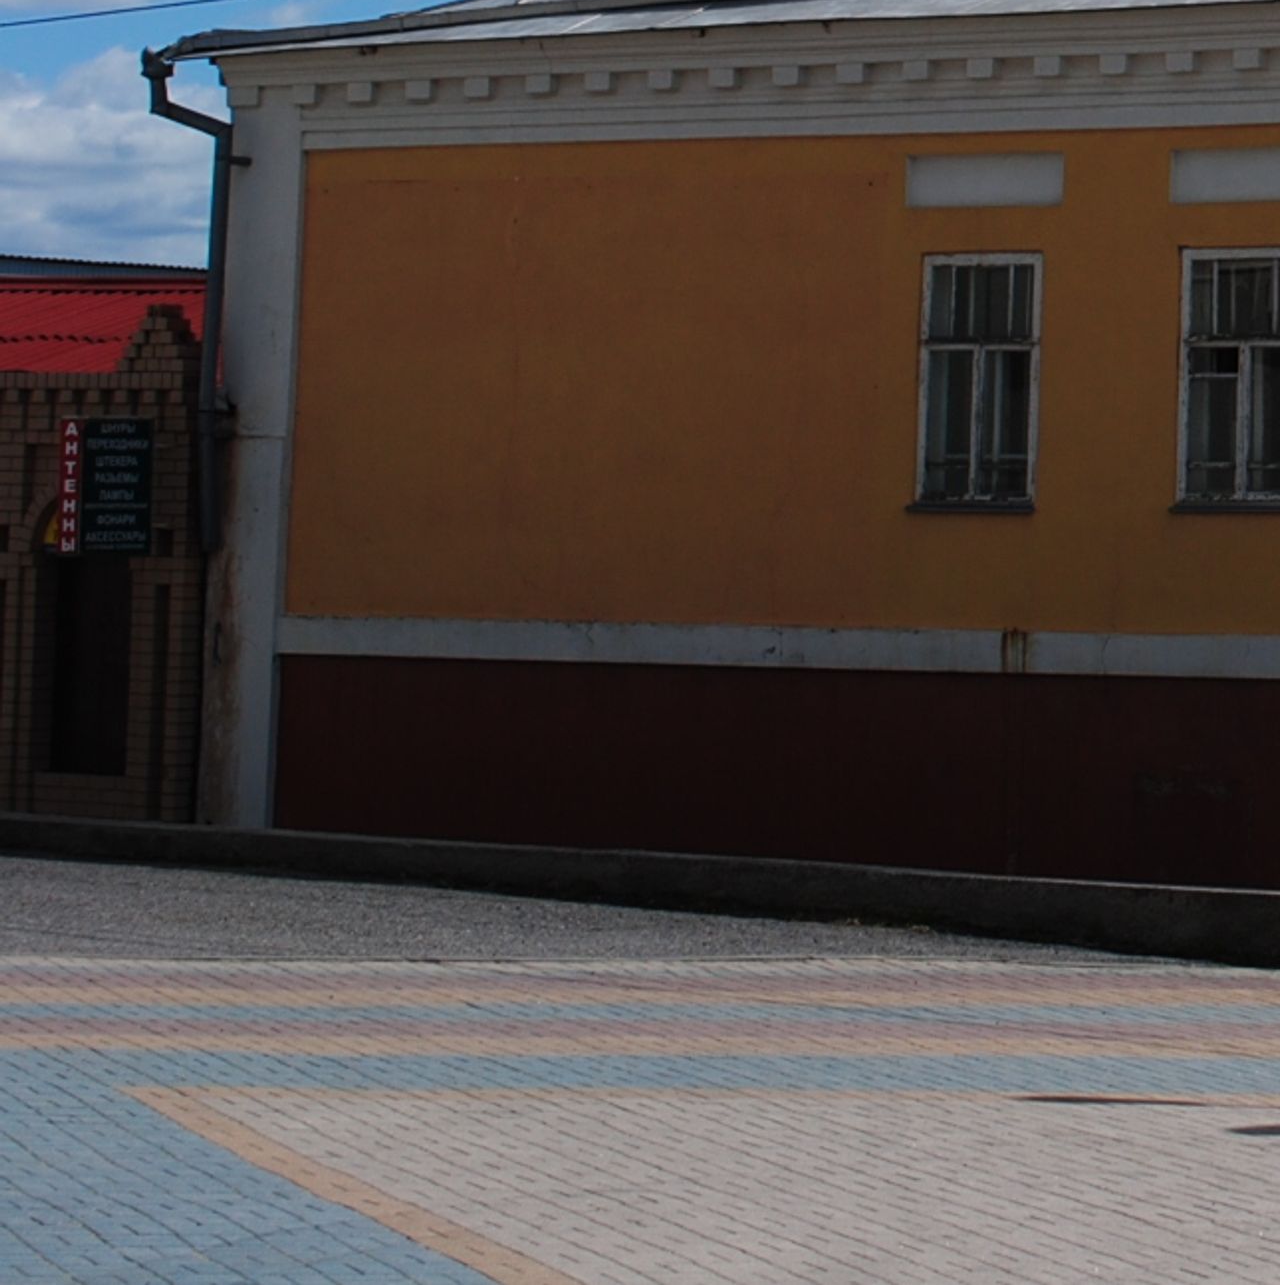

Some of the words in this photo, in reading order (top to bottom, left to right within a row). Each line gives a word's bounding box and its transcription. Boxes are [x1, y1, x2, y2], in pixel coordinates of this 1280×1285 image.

[95, 455, 138, 467] ШТЕКЕРА
[61, 421, 79, 552] АНТЕННЫ
[96, 514, 136, 525] ФОНАРИ
[84, 530, 146, 542] АКСЕССУАРЫ
